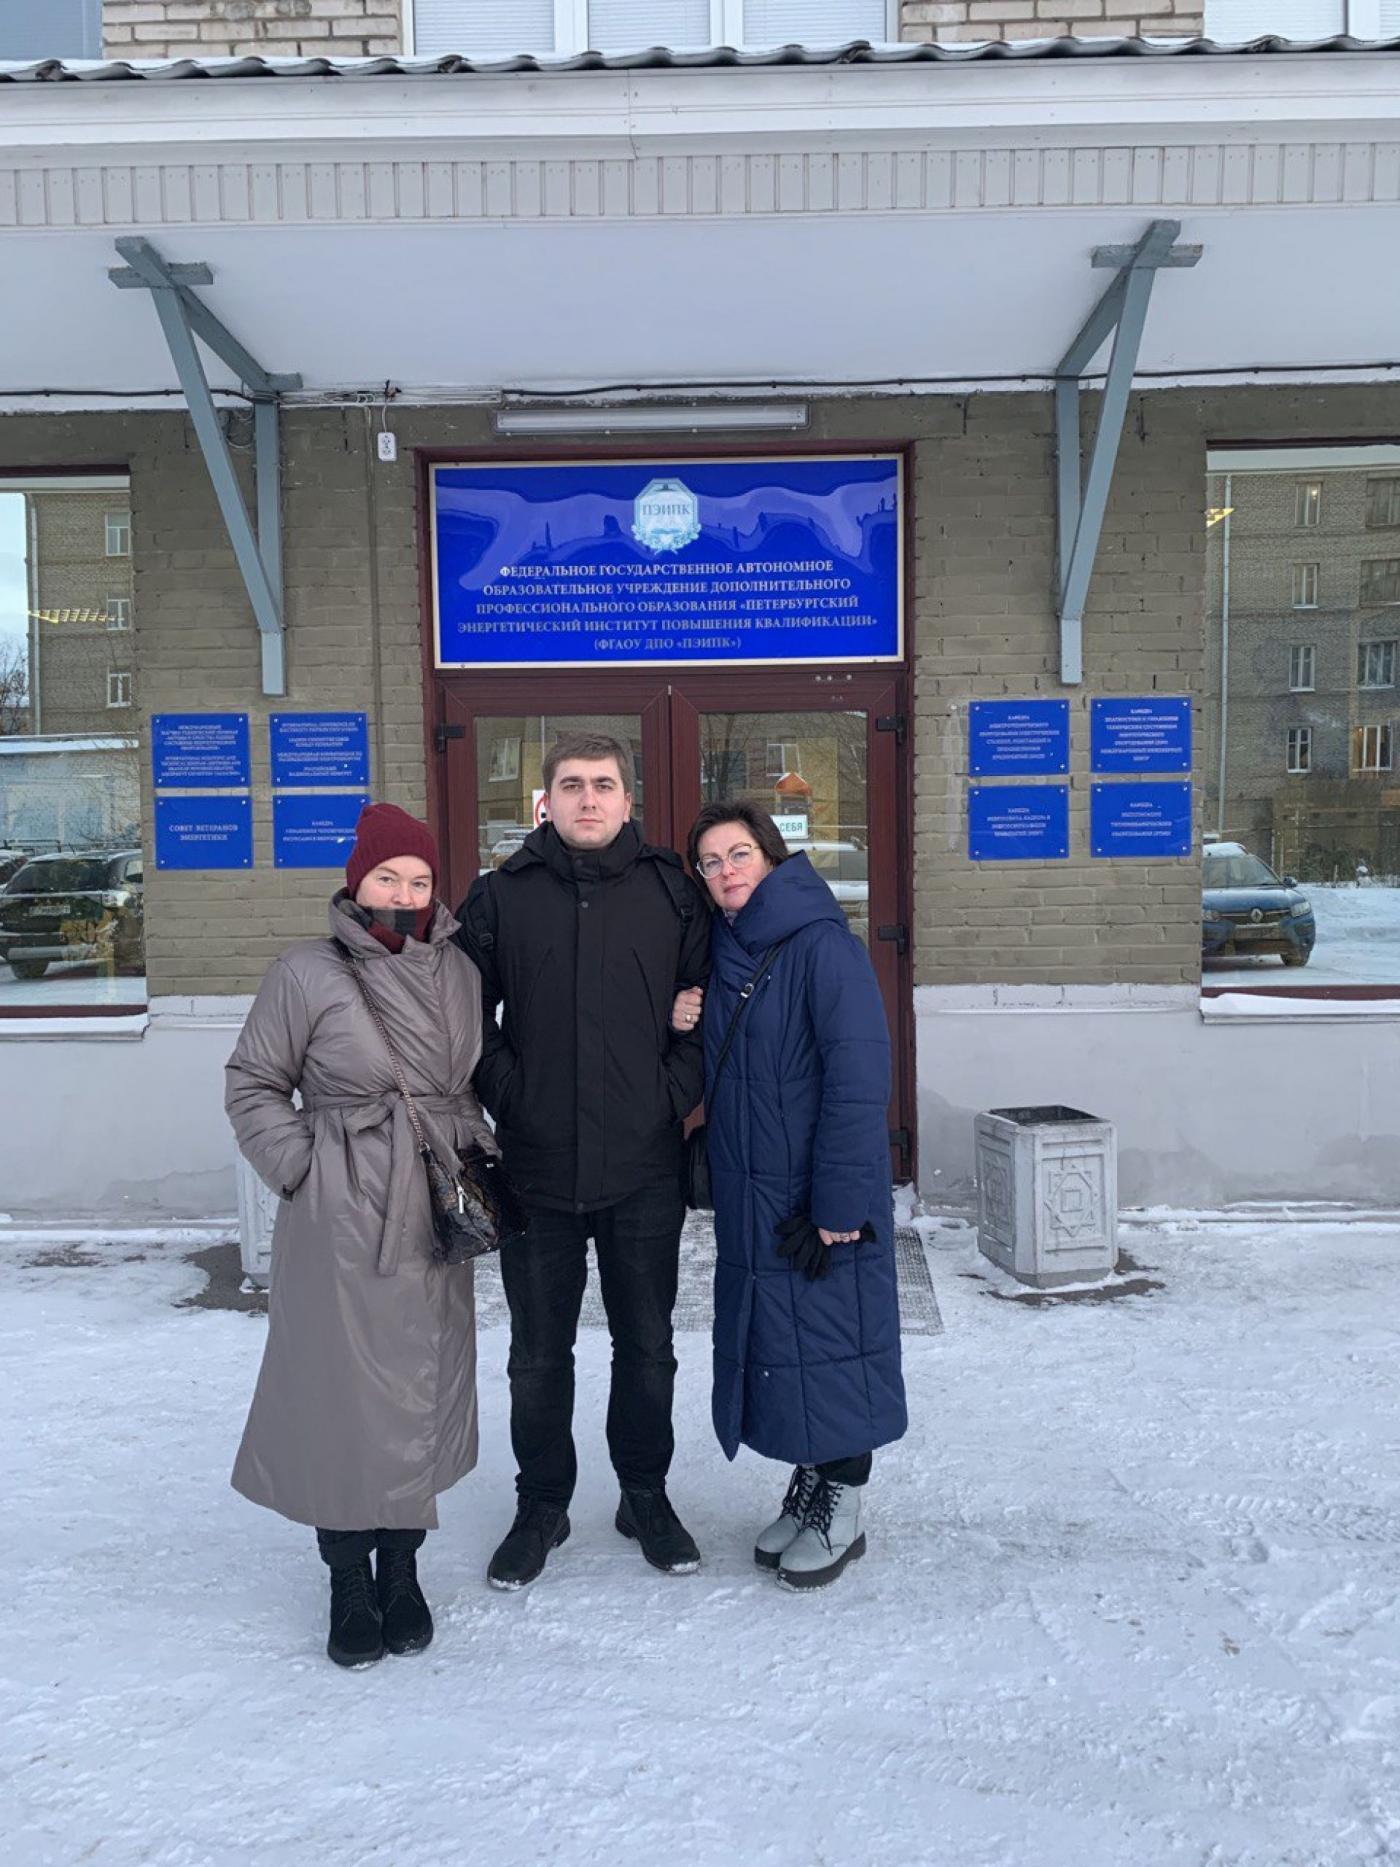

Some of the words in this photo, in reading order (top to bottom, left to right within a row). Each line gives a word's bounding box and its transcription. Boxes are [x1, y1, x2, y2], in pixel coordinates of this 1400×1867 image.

[642, 504, 690, 516] ПЭИПК
[500, 565, 597, 578] ФЕДЕРАЛЬНОЕ
[599, 562, 733, 577] ГОСУДАРСТВЕННОЕ
[736, 560, 833, 574] АВТОНОМНОЕ
[483, 584, 613, 596] ОБРАЗОВАТЕЛЬНОЕ
[617, 582, 708, 596] УЧРЕЖДЕНИЕ
[711, 579, 851, 594] ДОПОЛНИТЕЛЬНОГО
[476, 602, 635, 615] ПРОФЕССИОНАЛЬНОГО
[638, 599, 736, 613] ОБРАЗОВАНИЯ
[740, 595, 859, 611] «ПЕТЕРБУРГСКИЙ
[457, 620, 581, 633] ЭНЕРГЕТИЧЕСКИЙ
[585, 619, 658, 632] ИНСТИТУТ
[661, 618, 752, 631] ПОВЫШЕНИЯ
[755, 615, 878, 630] КВАЛИФИКАЦИИ»
[594, 638, 641, 650] (ФГАОУ
[644, 638, 674, 650] ДПО
[676, 636, 742, 649] «ПЭИПК»)
[168, 824, 194, 832] СОВЕТ
[779, 822, 803, 832] СЕБЯ
